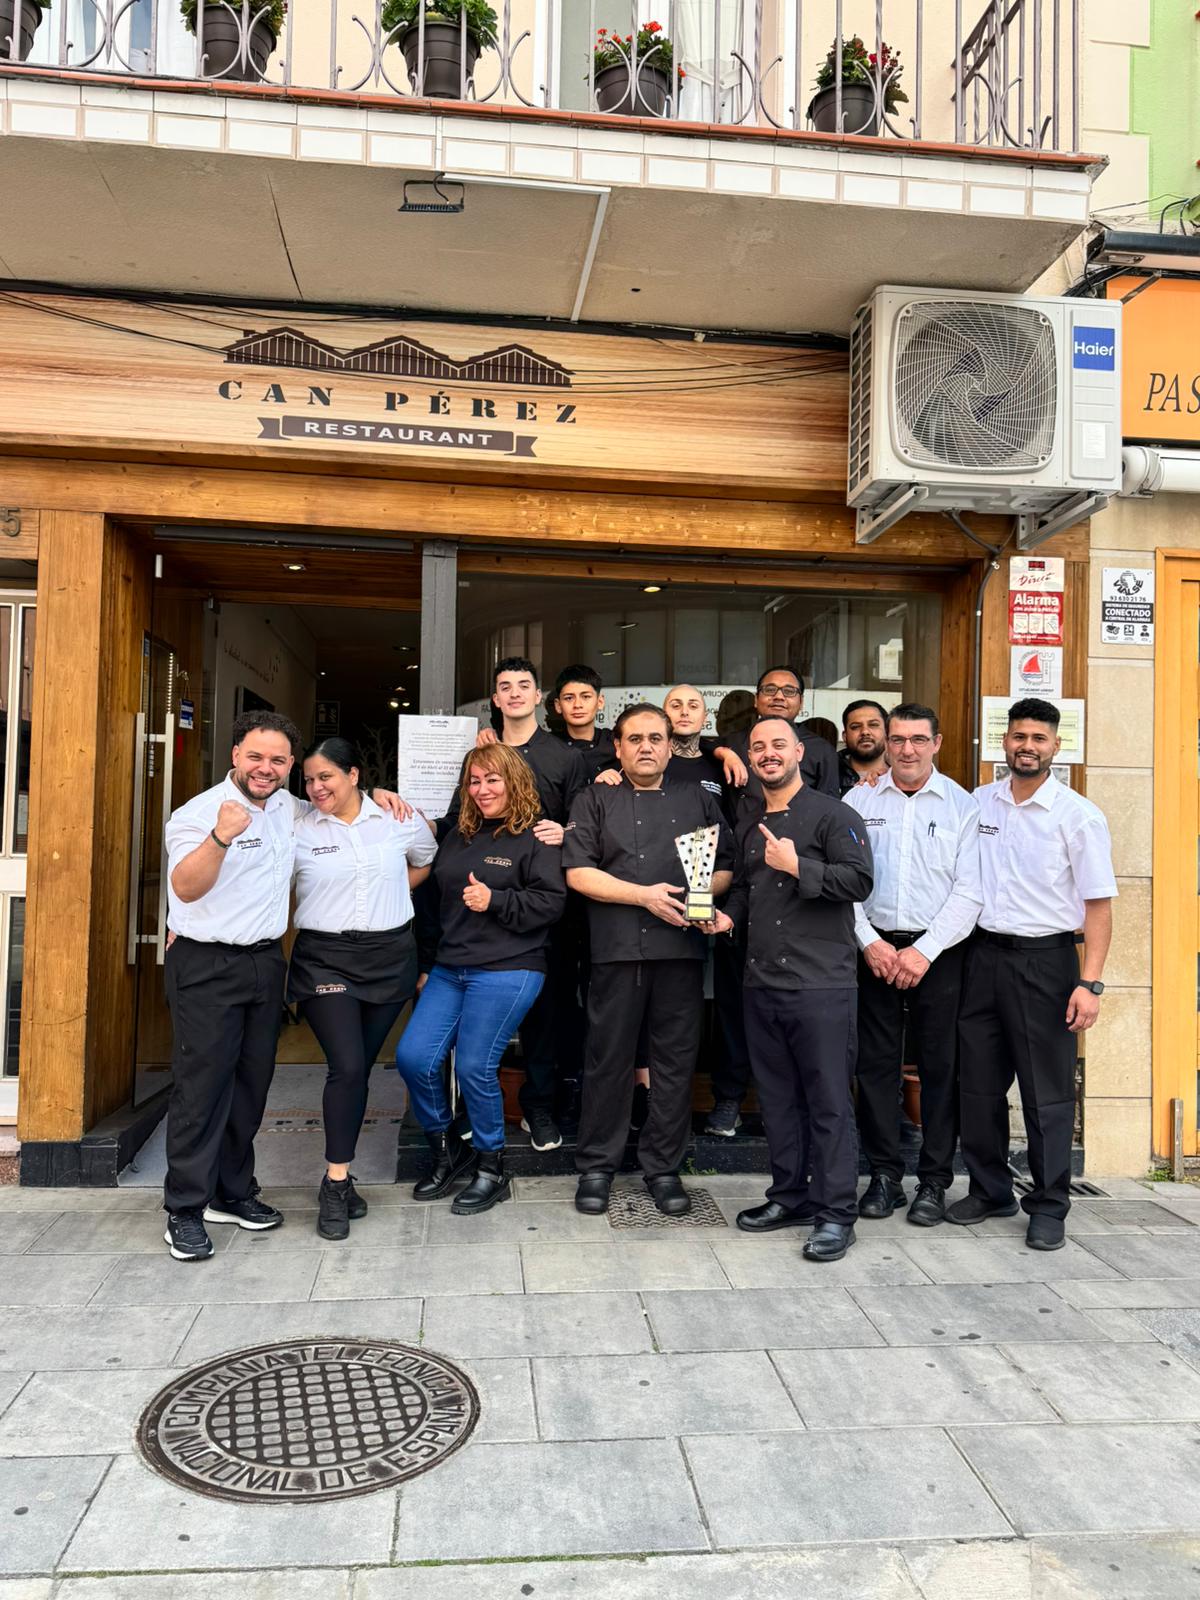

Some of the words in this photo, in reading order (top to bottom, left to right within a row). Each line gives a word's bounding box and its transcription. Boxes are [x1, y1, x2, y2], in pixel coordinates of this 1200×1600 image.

[1074, 341, 1114, 357] Haier
[218, 380, 333, 406] CAN
[384, 390, 577, 424] PÉREZ
[1143, 372, 1200, 414] PAS
[304, 421, 493, 447] RESTAURANT
[1014, 593, 1059, 606] Alarma
[1105, 608, 1151, 617] CONECTADO
[292, 1346, 461, 1398] TELEFONICA
[380, 1403, 465, 1471] ESPAÑA
[166, 1434, 303, 1491] NACIONAL
[319, 1462, 376, 1490] DE
